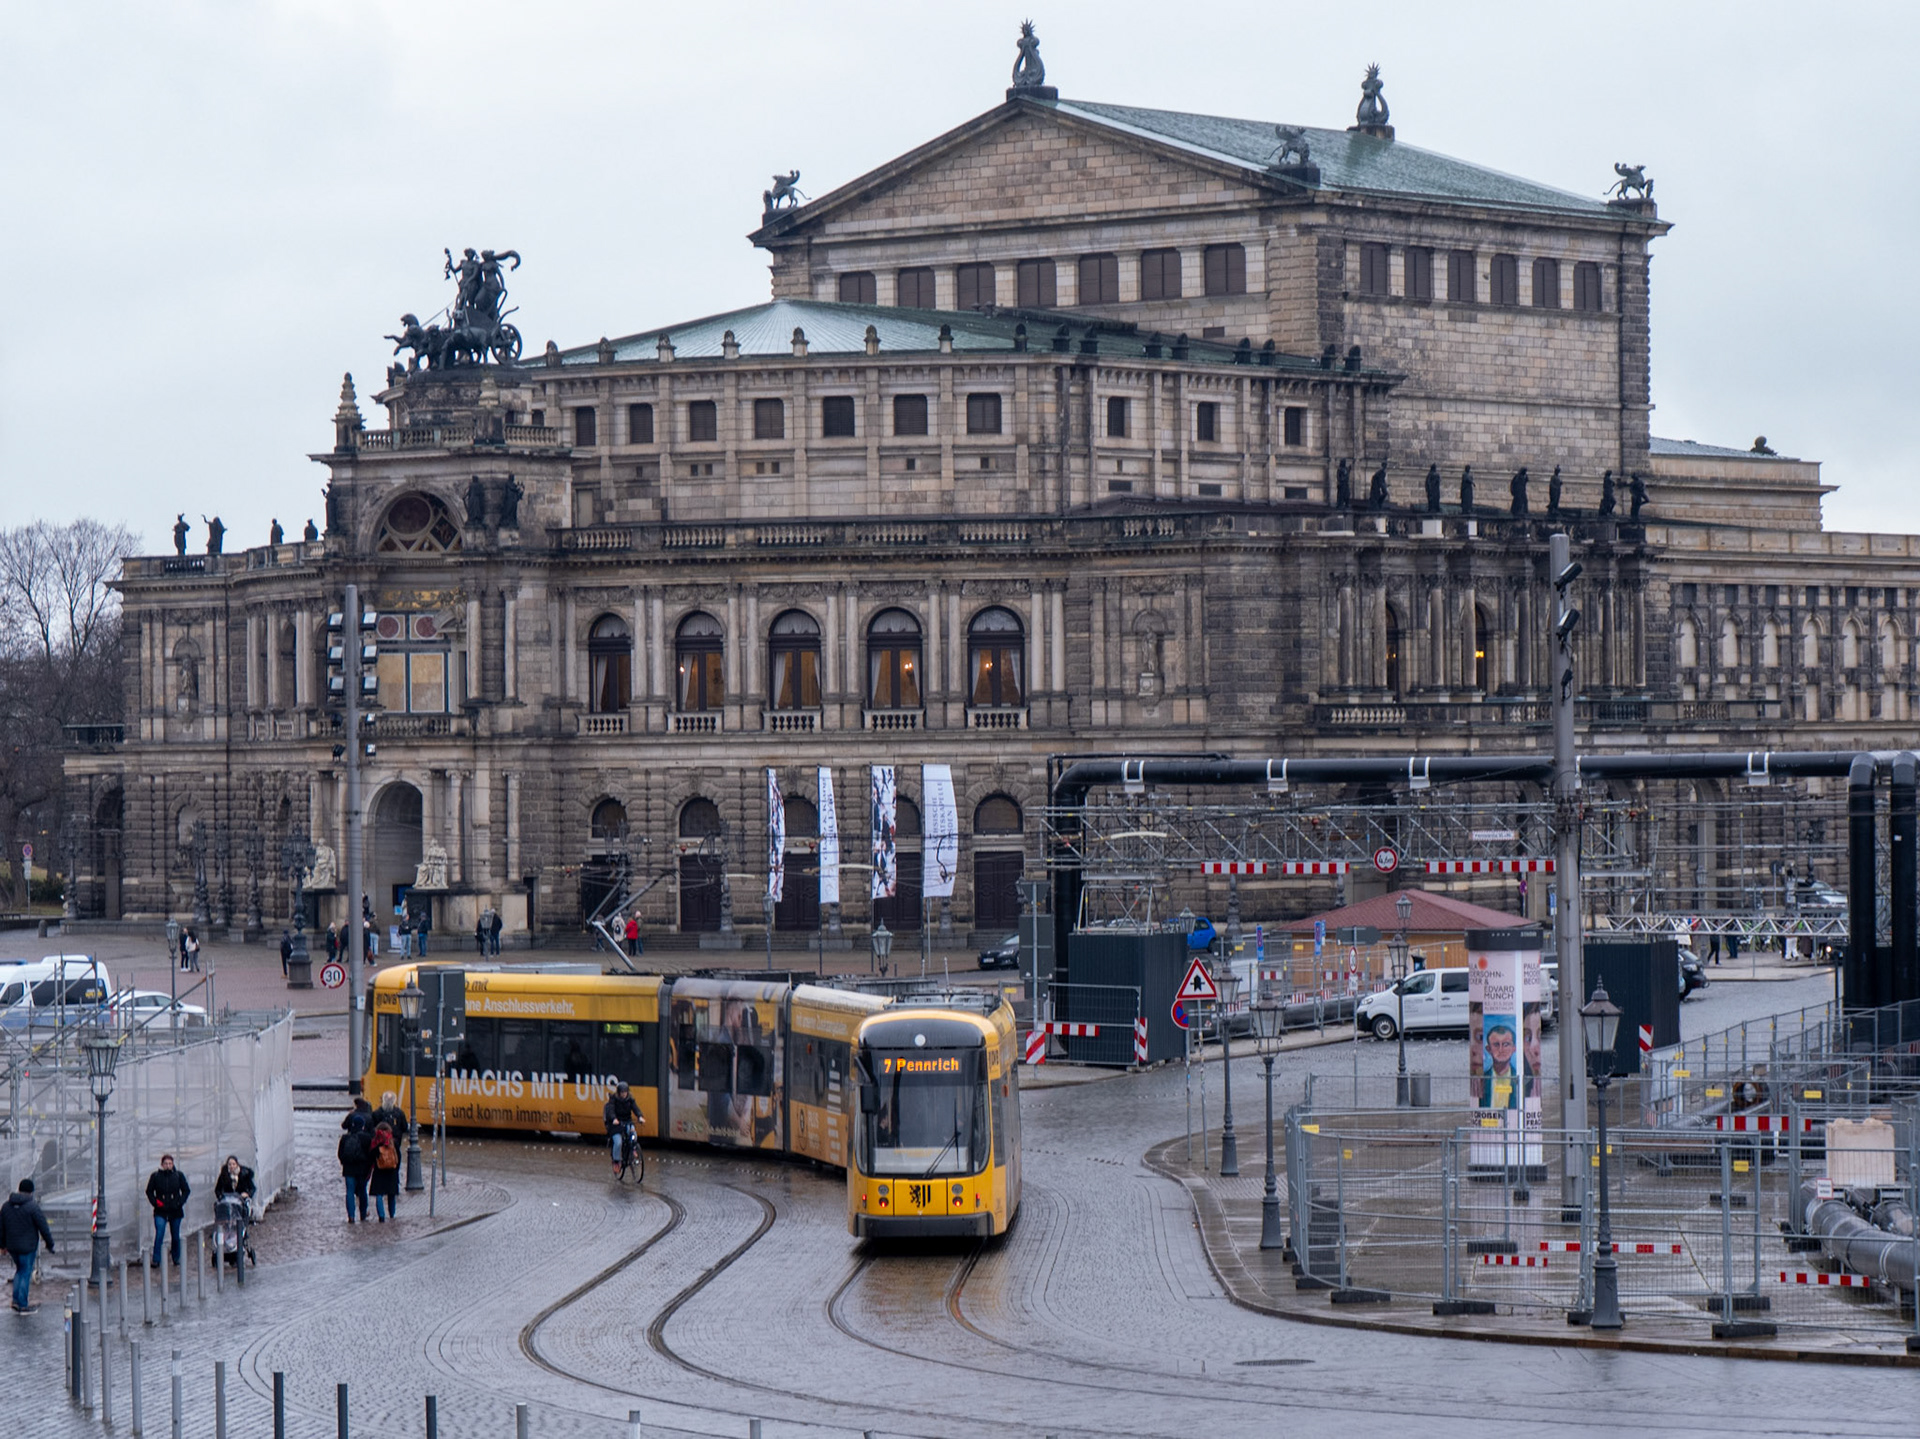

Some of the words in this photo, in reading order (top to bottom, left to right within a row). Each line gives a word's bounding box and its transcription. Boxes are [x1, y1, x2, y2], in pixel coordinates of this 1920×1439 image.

[325, 970, 341, 982] 30
[1484, 985, 1515, 993] EDVARD
[1484, 992, 1514, 1000] MUNCH
[483, 997, 576, 1016] Anschlussverkehr,
[884, 1058, 892, 1074] 7
[896, 1057, 959, 1072] Pennrich
[450, 1068, 524, 1098] MACHS
[531, 1071, 568, 1100] MIT
[575, 1073, 619, 1102] UNS
[452, 1103, 473, 1119] und
[477, 1104, 513, 1122] komm
[516, 1105, 554, 1123] immer
[557, 1112, 575, 1125] an.
